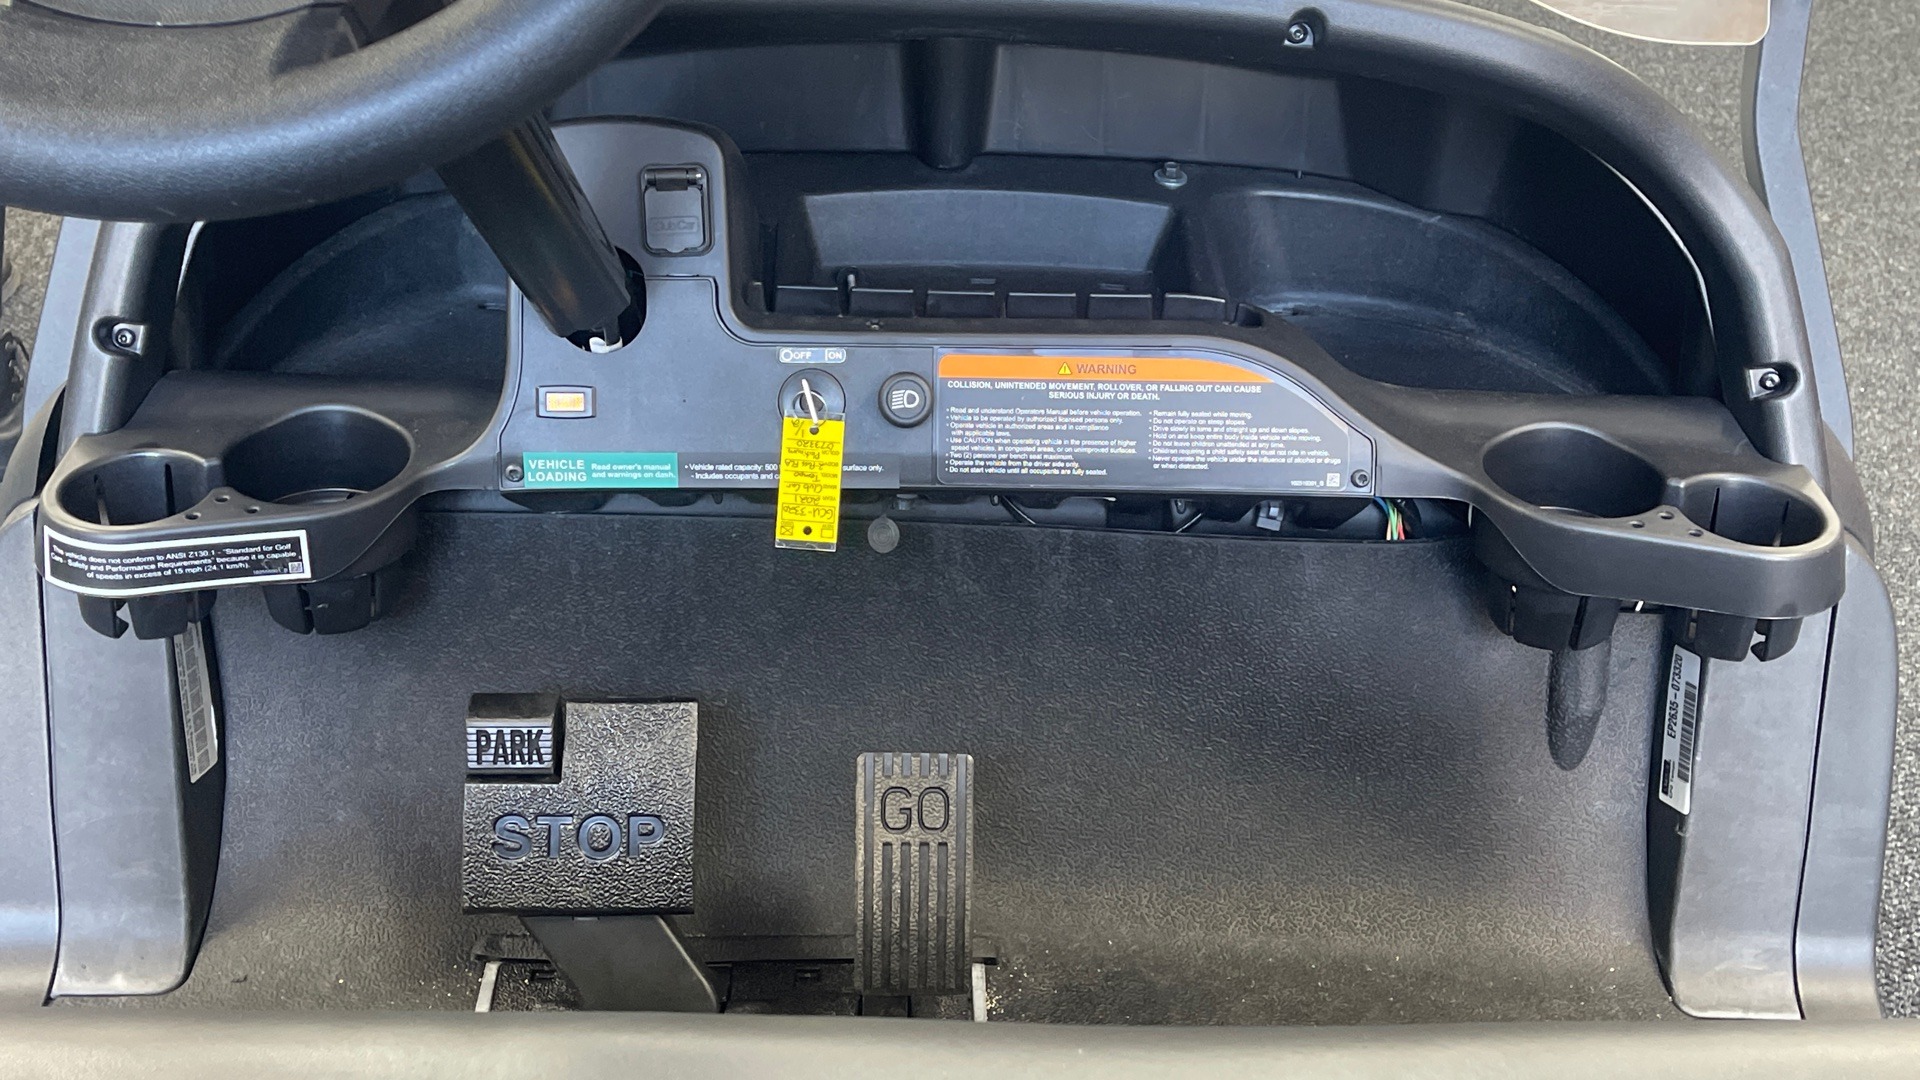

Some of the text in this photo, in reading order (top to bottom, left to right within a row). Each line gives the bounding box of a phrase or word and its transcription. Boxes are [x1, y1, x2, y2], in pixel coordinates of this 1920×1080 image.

[1077, 364, 1137, 374] WARNING
[948, 381, 993, 389] COLLISION,
[995, 382, 1046, 390] UNINTENDED
[1049, 382, 1095, 391] MOVEMENT,
[1098, 383, 1144, 391] ROLLOVER,
[528, 460, 585, 469] VEHICLE
[734, 464, 764, 472] capacity:
[528, 472, 587, 481] LOADING
[803, 484, 822, 493] Club
[106, 564, 156, 572] Performance
[216, 555, 249, 563] because
[266, 551, 296, 559] capable
[185, 566, 202, 575] mph
[476, 728, 545, 765] PARK
[879, 786, 952, 831] GO
[491, 814, 666, 861] STOP
